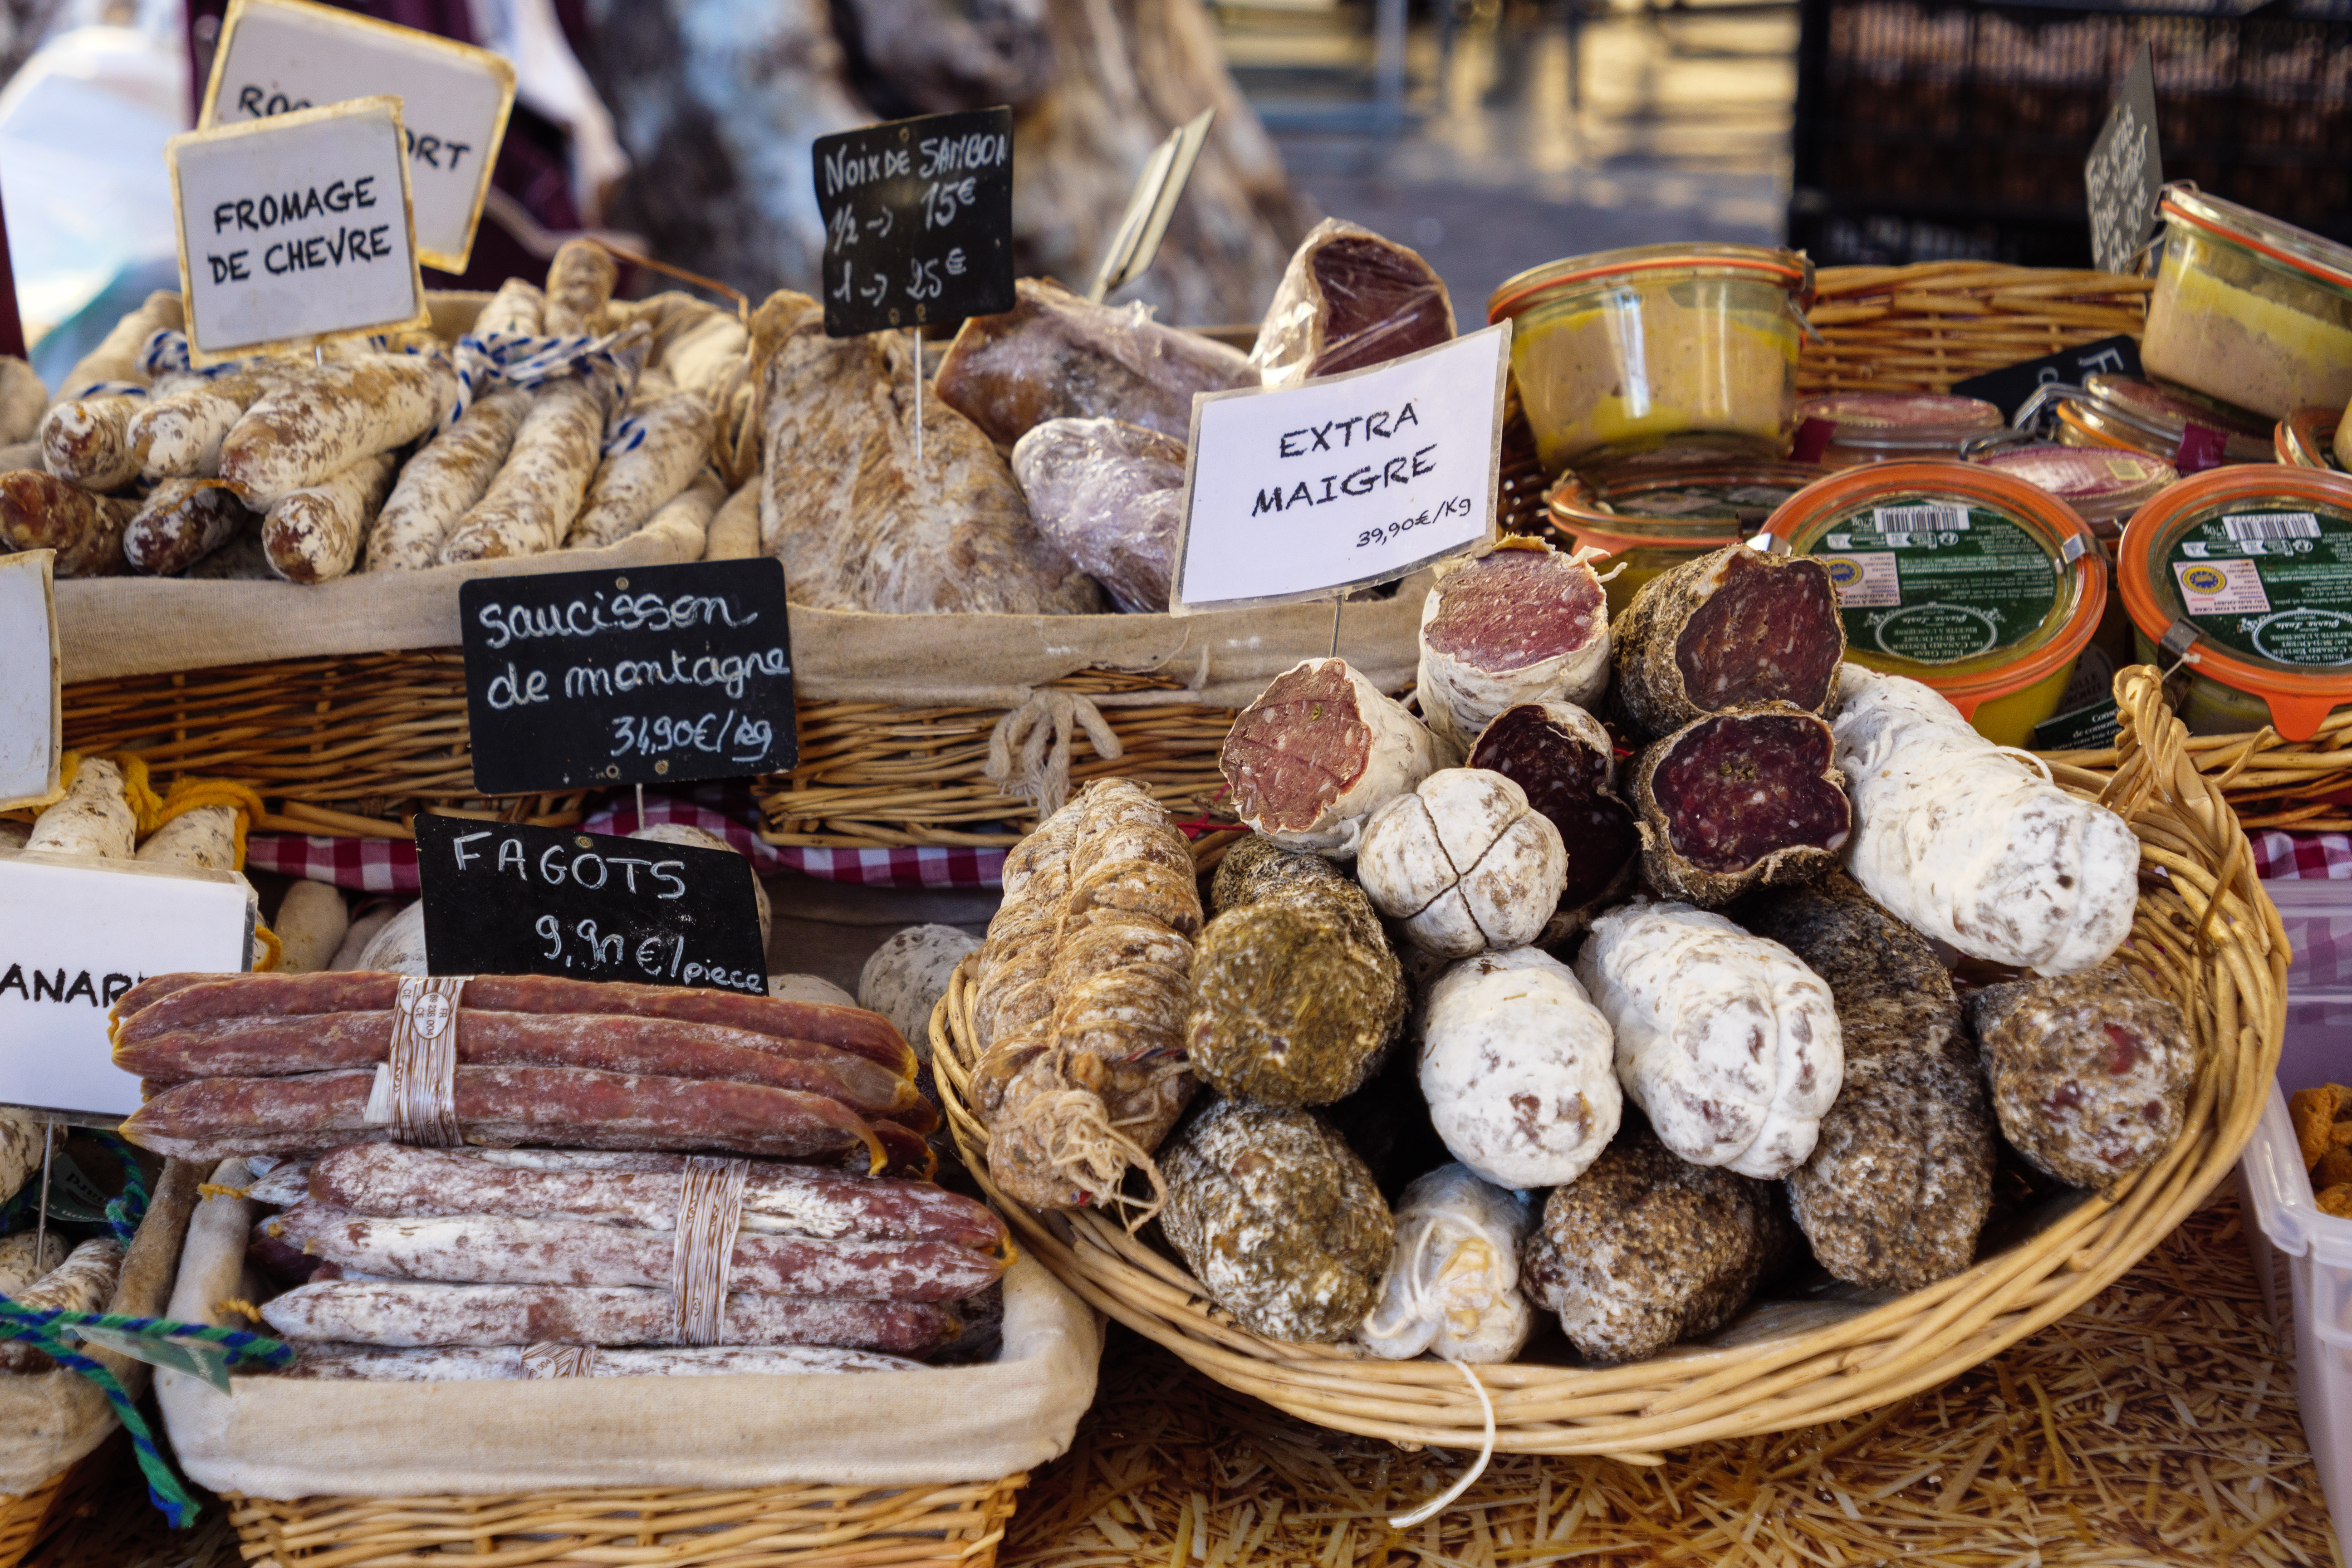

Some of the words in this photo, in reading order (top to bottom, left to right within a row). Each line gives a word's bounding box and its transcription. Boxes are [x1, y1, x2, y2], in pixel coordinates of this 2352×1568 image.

[214, 176, 377, 234] FROMAGE
[208, 250, 250, 284] DE
[264, 224, 392, 275] CHEVRE
[1279, 402, 1419, 458] EXTRA
[1251, 443, 1438, 517] MAIGRE
[487, 662, 549, 710] de
[564, 647, 790, 700] montagne
[454, 831, 686, 900] FAGOTS
[402, 988, 412, 1000] CE
[416, 1007, 425, 1019] CE
[440, 1008, 448, 1019] FR
